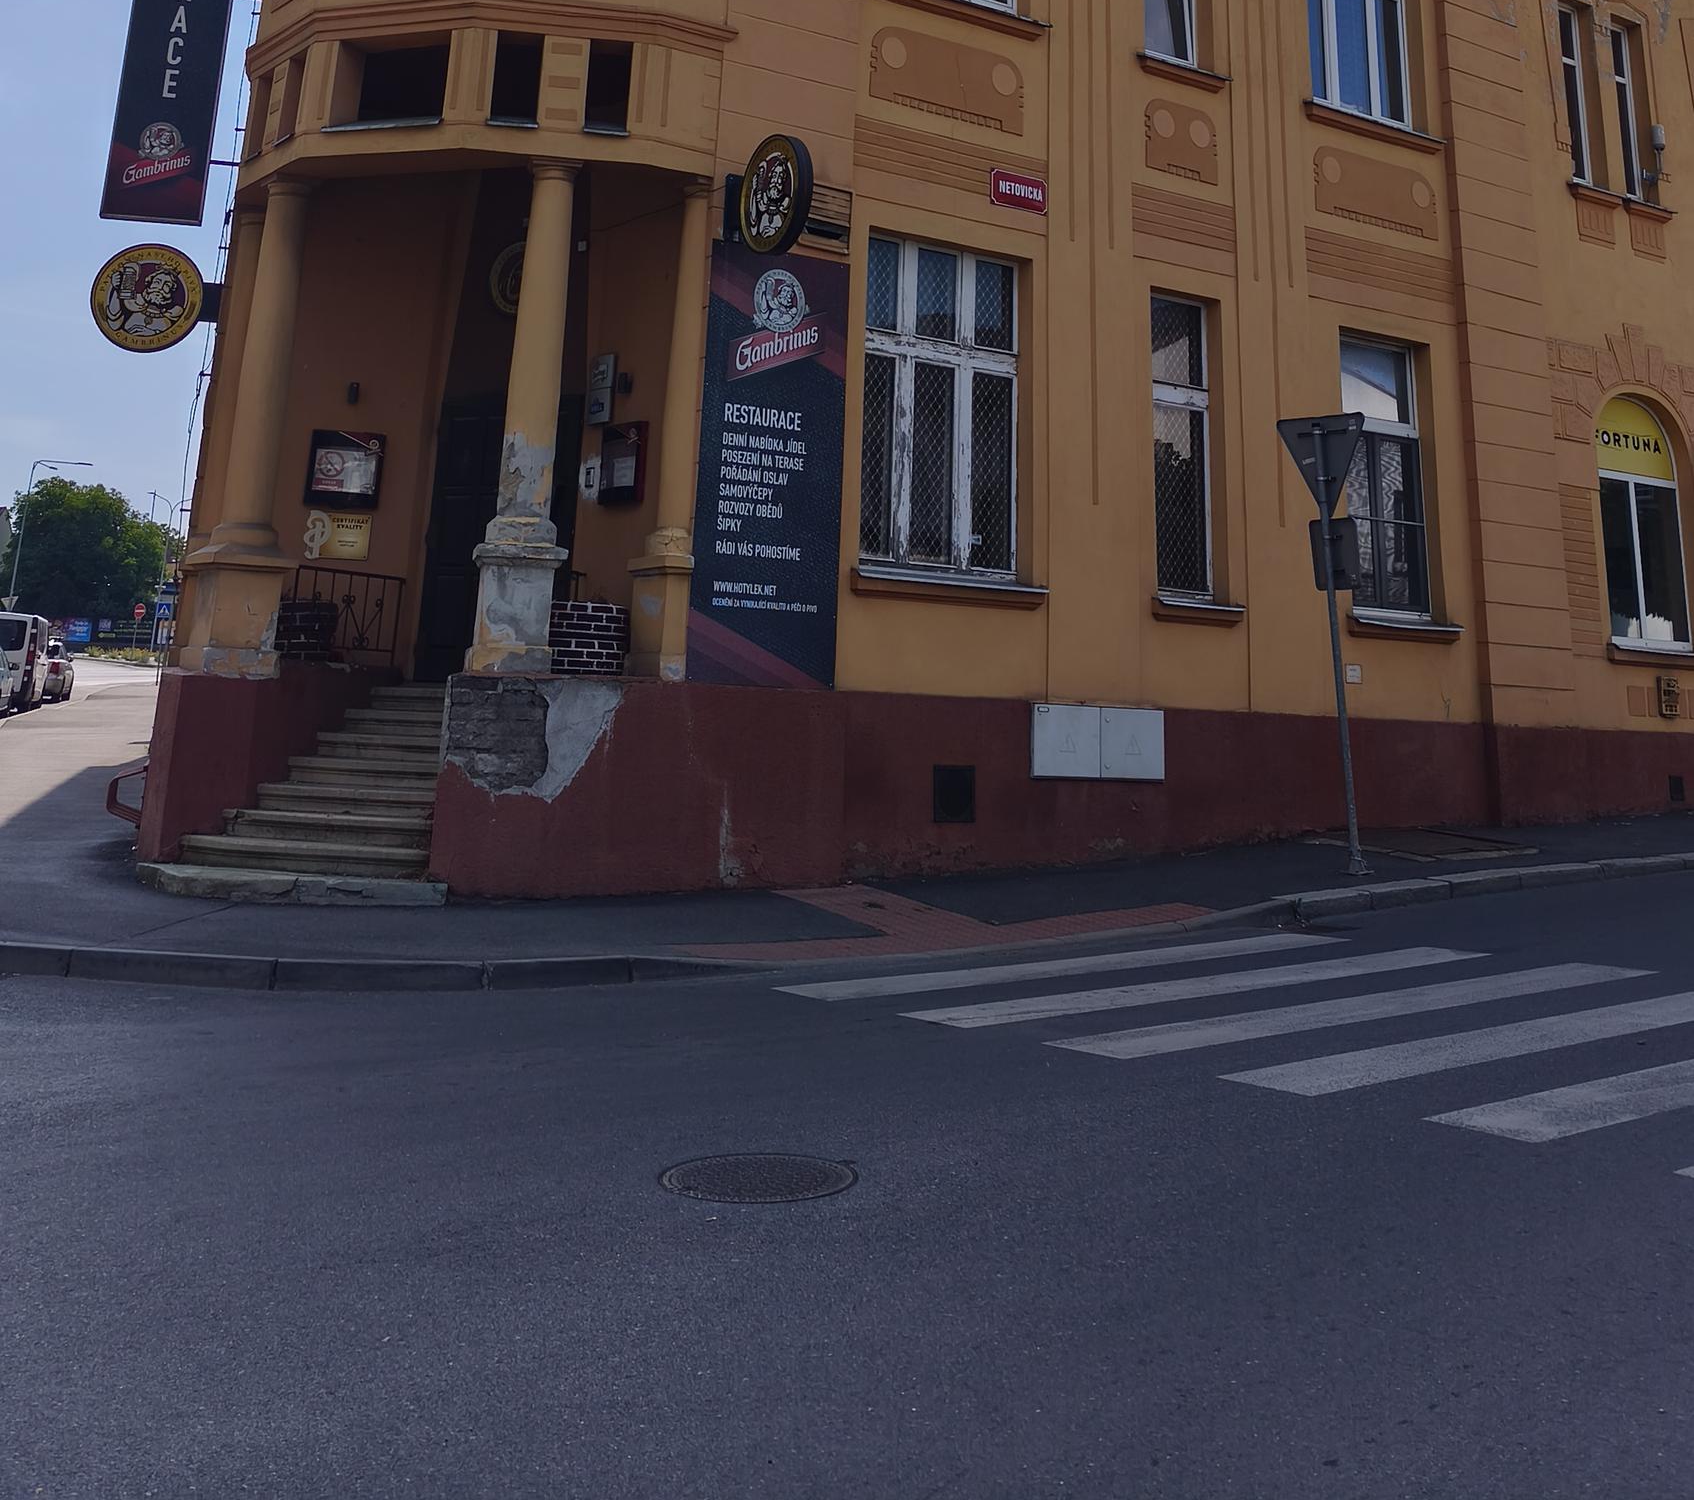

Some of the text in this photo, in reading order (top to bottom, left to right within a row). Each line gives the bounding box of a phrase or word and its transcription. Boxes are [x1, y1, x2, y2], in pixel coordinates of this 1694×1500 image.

[122, 155, 191, 184] Gambrinus
[998, 179, 1043, 202] NETOVICKÁ
[735, 326, 819, 370] Gambrinus
[724, 402, 802, 431] RESTAURACE
[722, 432, 807, 455] DENNÍ NABÍDKA JÍDEL
[721, 449, 804, 471] POSEZENÍ NA TERASE
[720, 465, 789, 486] POŘÁDÁNÍ OSLAV
[719, 483, 773, 501] SAMOVÝČEPY
[718, 500, 783, 519] ROZVOZY OBĚDŮ
[716, 514, 742, 532] ŠIPKY
[715, 538, 801, 561] RÁDI VÁS POHOSTÍME
